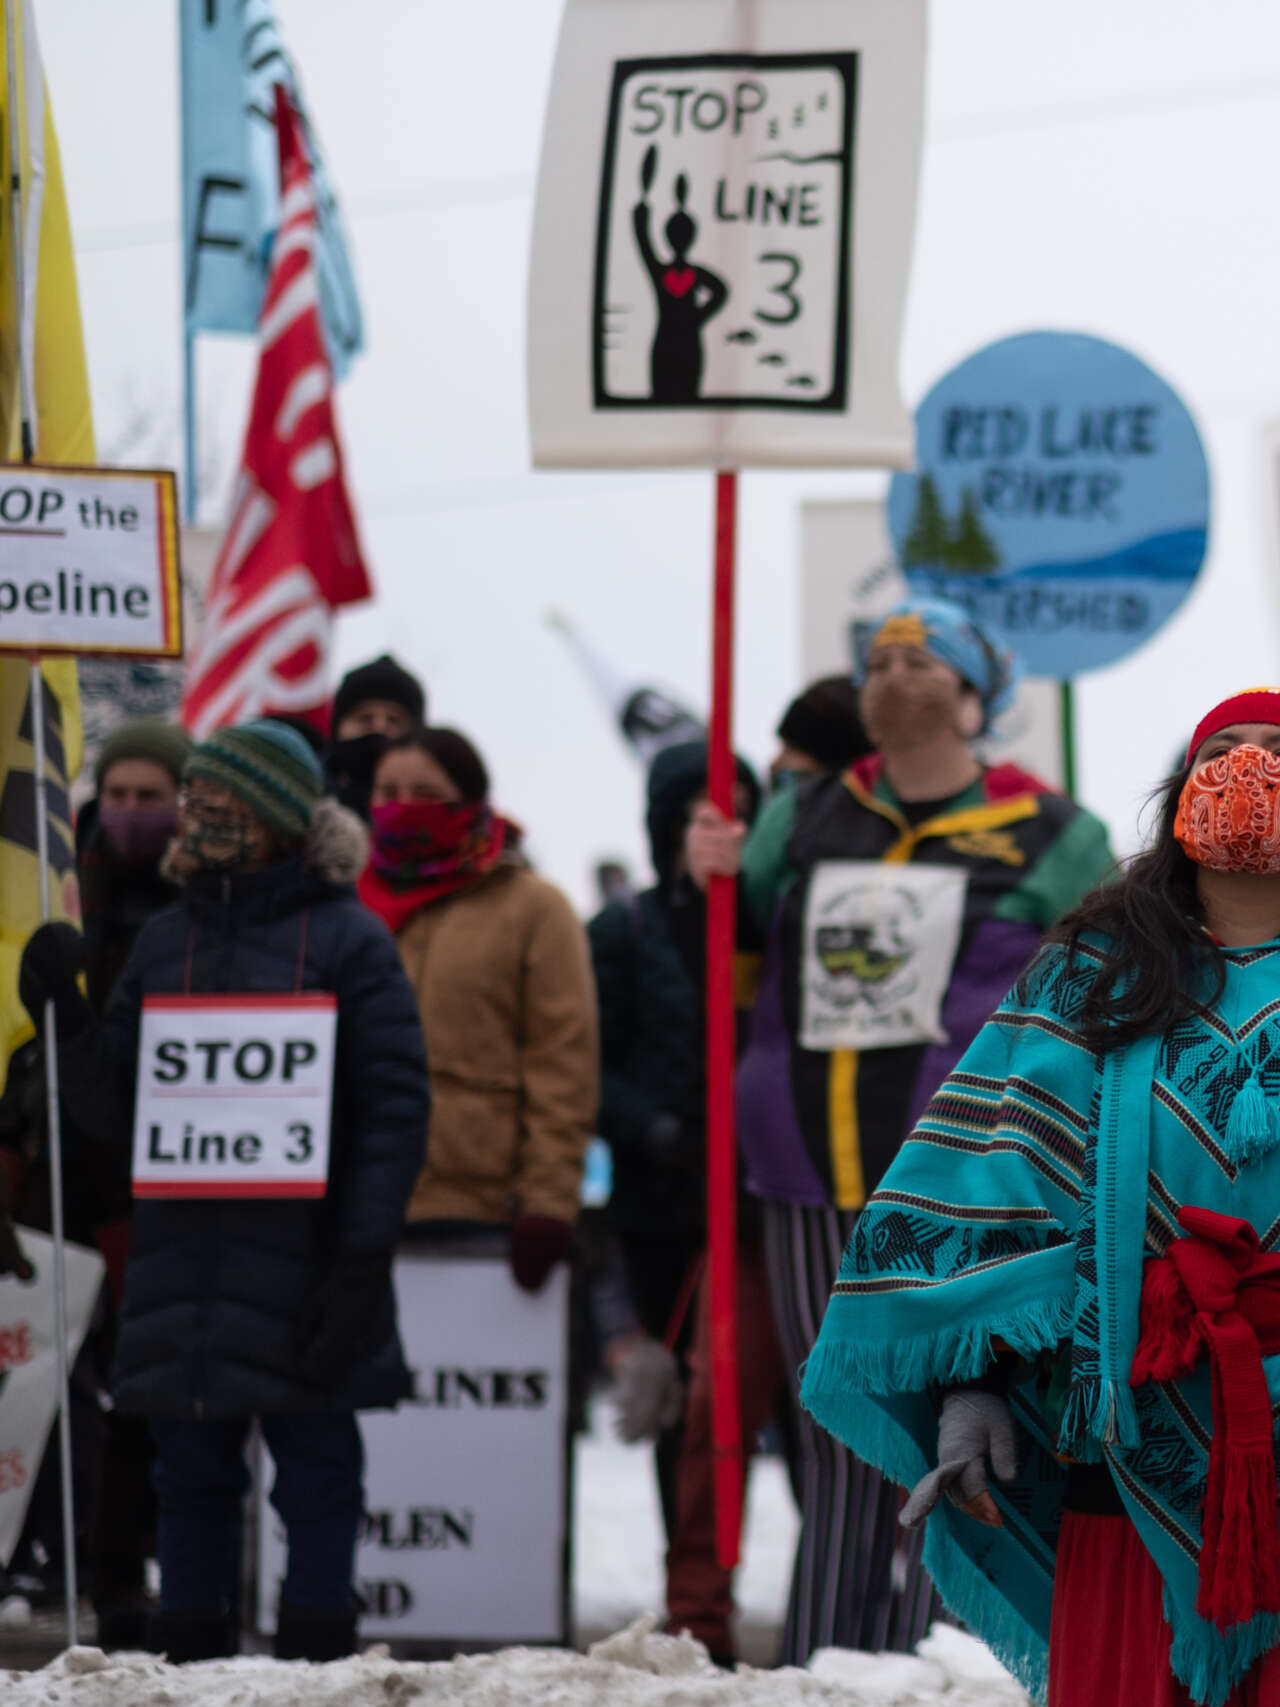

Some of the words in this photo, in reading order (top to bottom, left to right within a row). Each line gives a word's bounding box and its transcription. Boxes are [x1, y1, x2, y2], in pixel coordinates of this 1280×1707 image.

[631, 77, 767, 138] STOP
[713, 178, 823, 227] LINE
[753, 251, 804, 325] 3
[940, 402, 1030, 459] RED
[1041, 402, 1160, 459] LAKE
[79, 496, 140, 532] the
[981, 465, 1121, 521] RIVER
[152, 1038, 319, 1084] STOP
[147, 1121, 263, 1166] Line
[284, 1121, 314, 1165] 3
